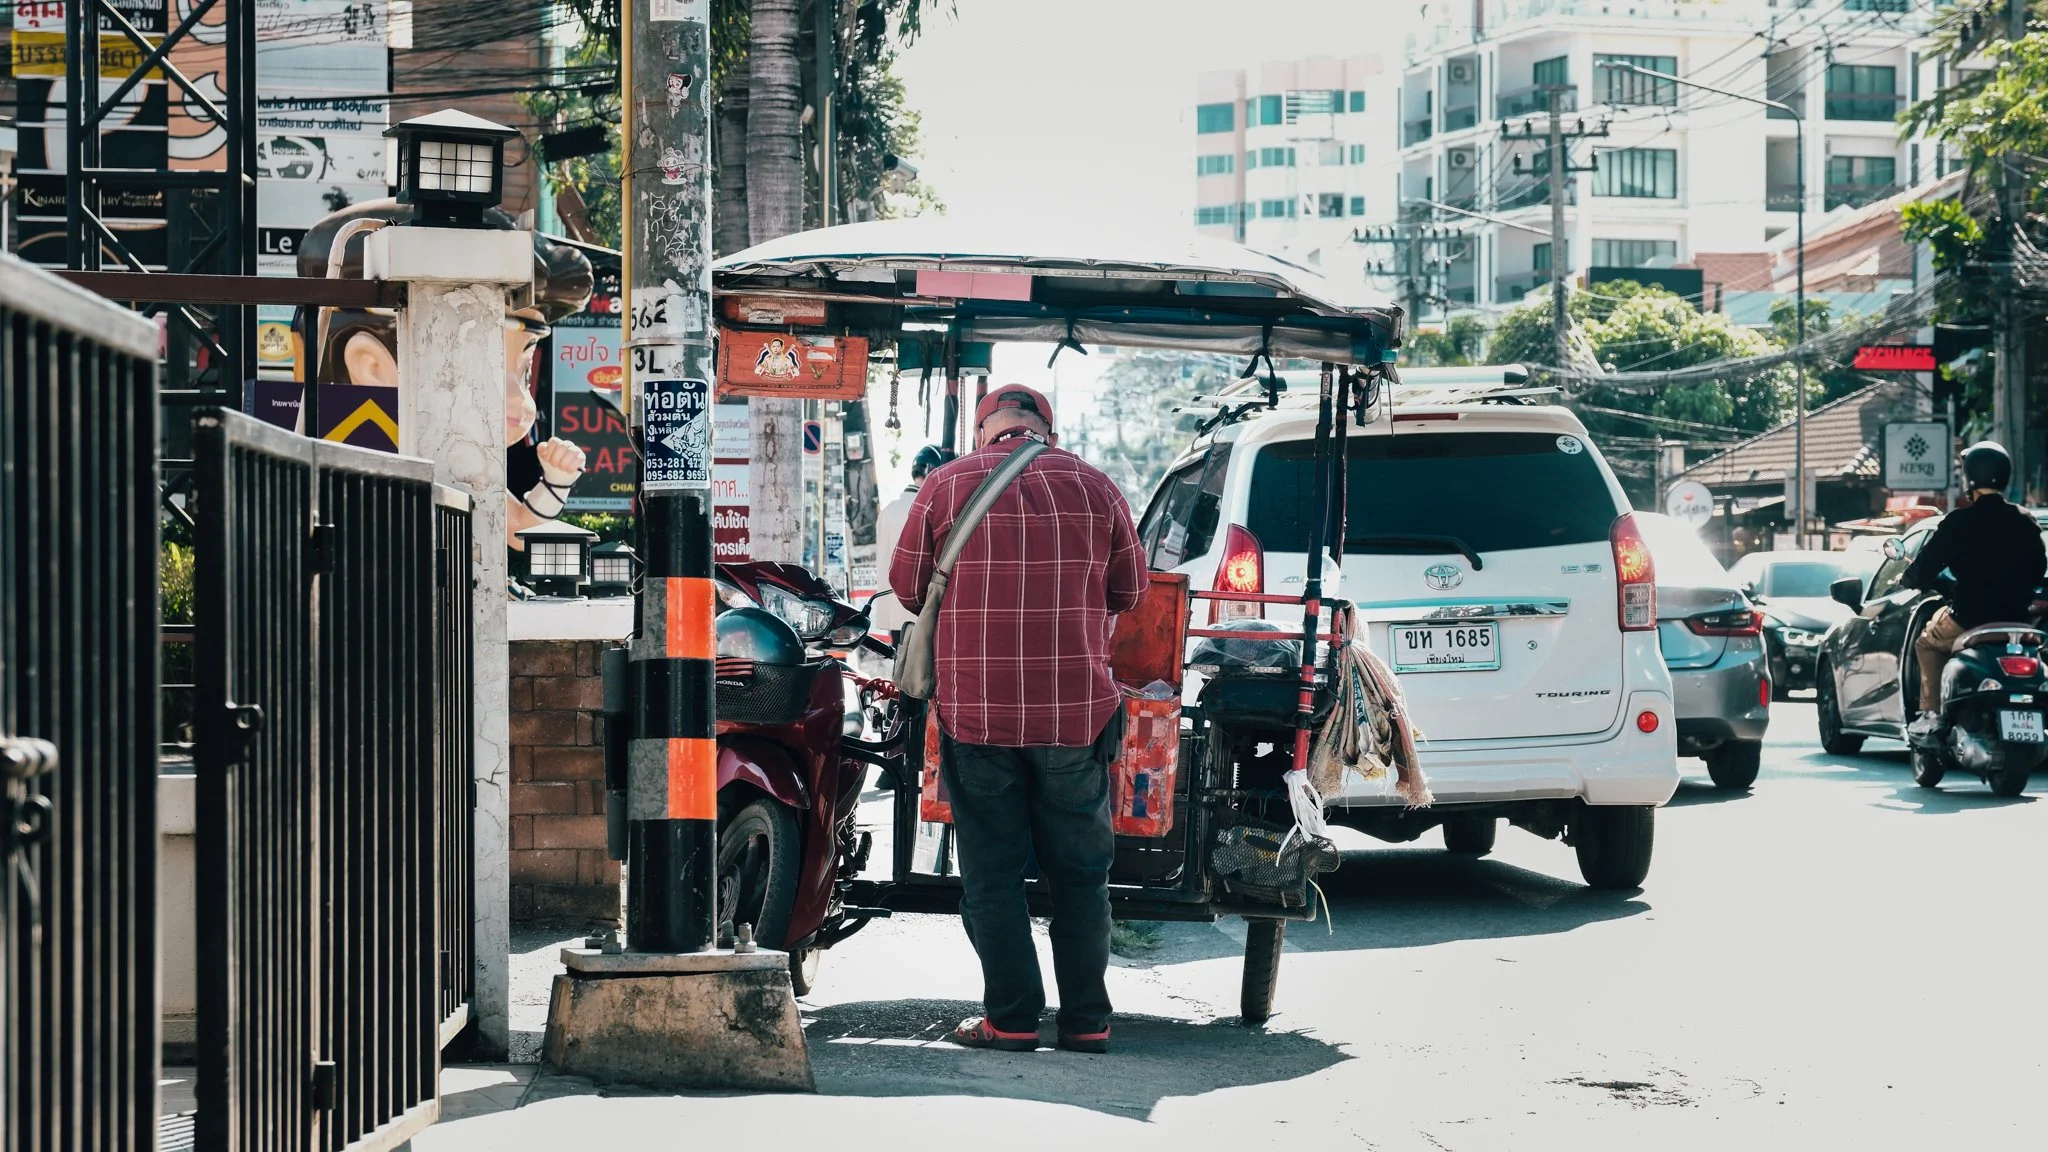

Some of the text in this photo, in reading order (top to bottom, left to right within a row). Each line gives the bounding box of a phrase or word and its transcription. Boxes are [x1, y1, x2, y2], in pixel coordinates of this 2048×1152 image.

[332, 99, 382, 116] Bodyline
[265, 231, 292, 253] Le
[560, 336, 608, 369] สุขใจ
[645, 382, 705, 409] ท่อตัน
[646, 458, 685, 469] 053-281
[1900, 462, 1935, 477] HERB
[646, 469, 706, 480] 095-682 9695
[1405, 628, 1490, 649] ขห 1685
[1535, 689, 1611, 698] TOURING
[2008, 731, 2039, 742] 8059
